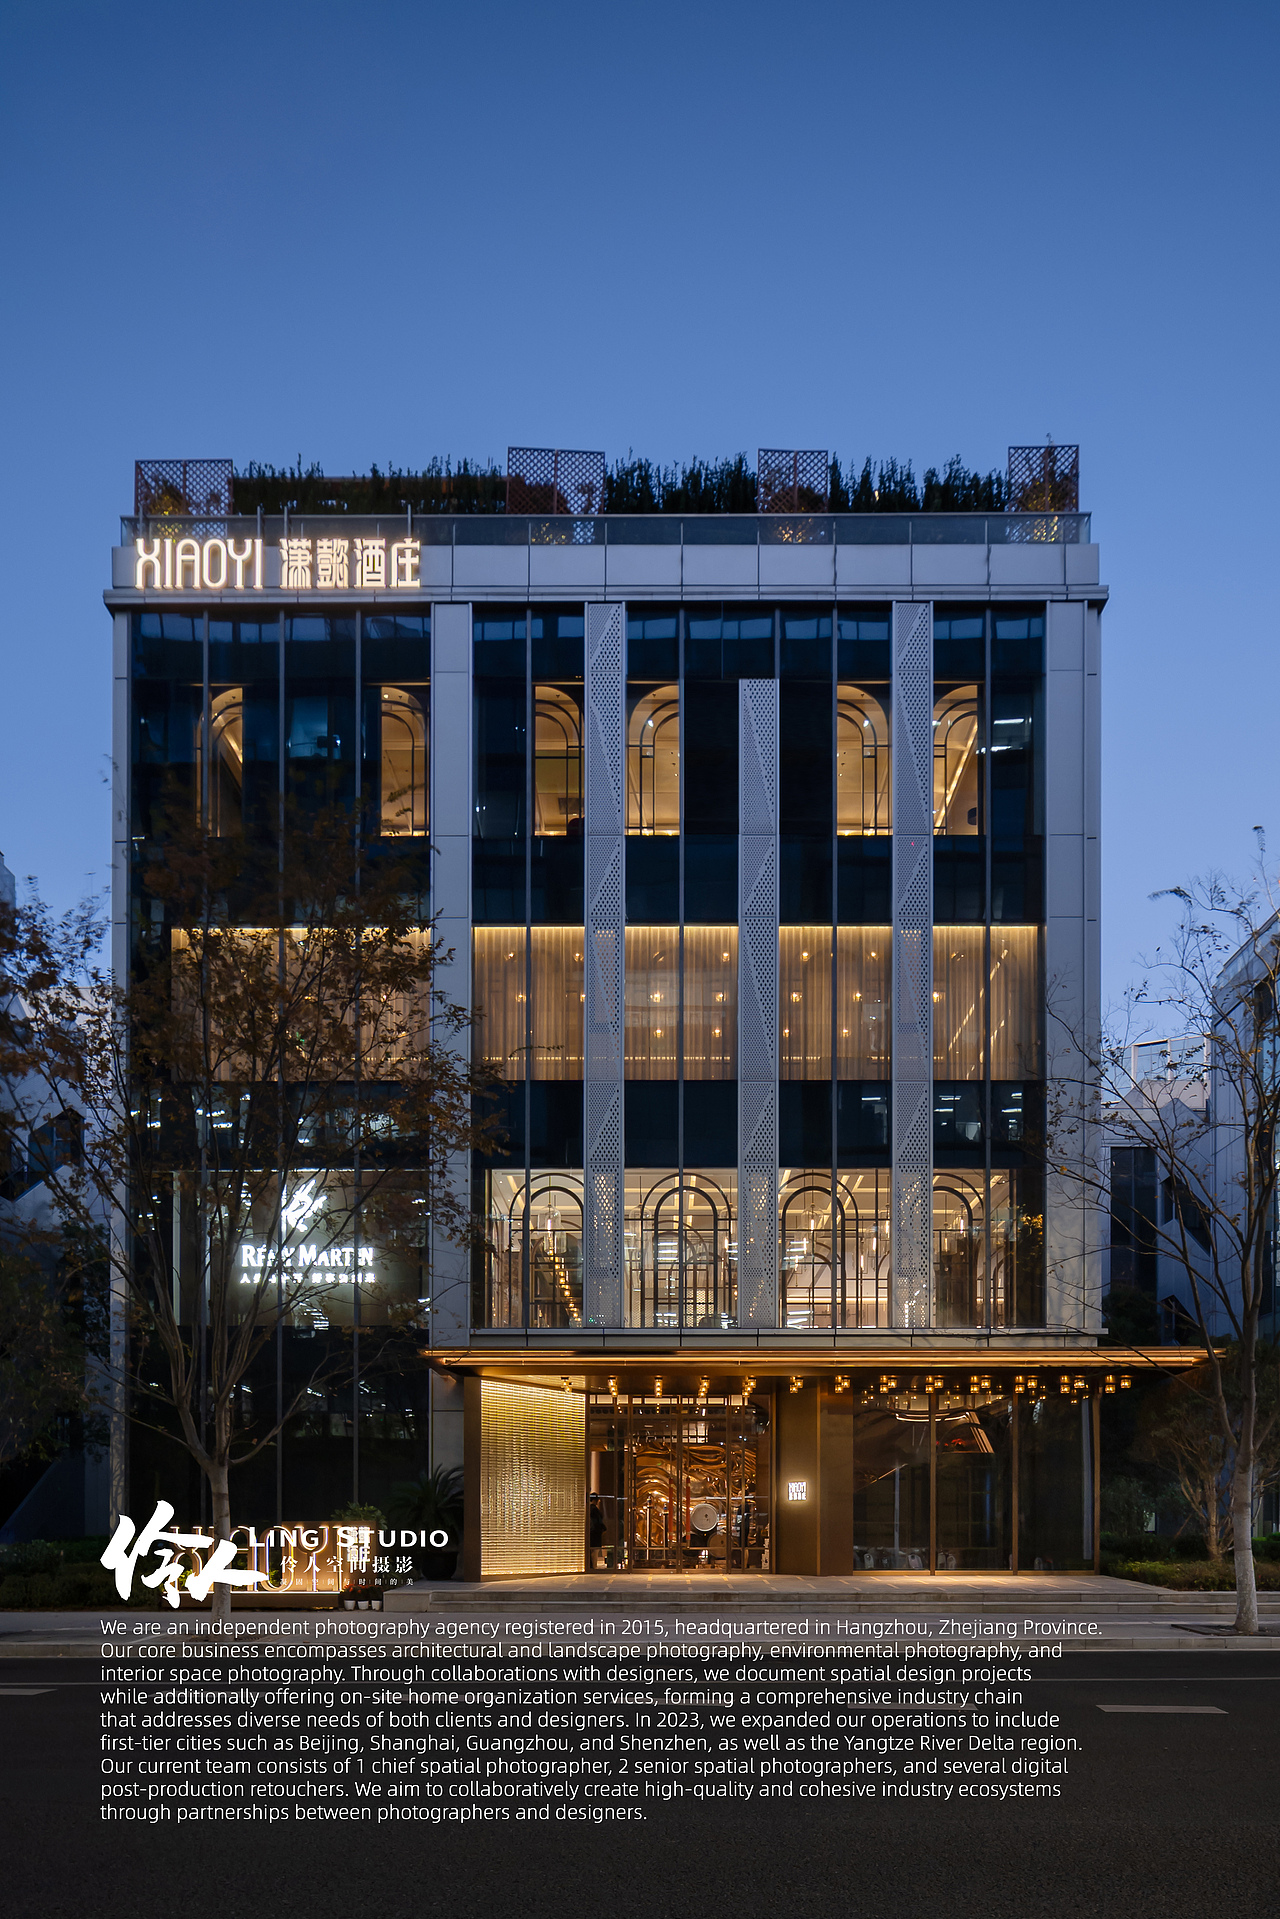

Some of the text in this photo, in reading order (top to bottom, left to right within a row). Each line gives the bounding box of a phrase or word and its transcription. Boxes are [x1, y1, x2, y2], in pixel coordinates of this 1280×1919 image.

[134, 538, 264, 590] XIAOYI
[279, 537, 421, 590] 潇懿酒庄
